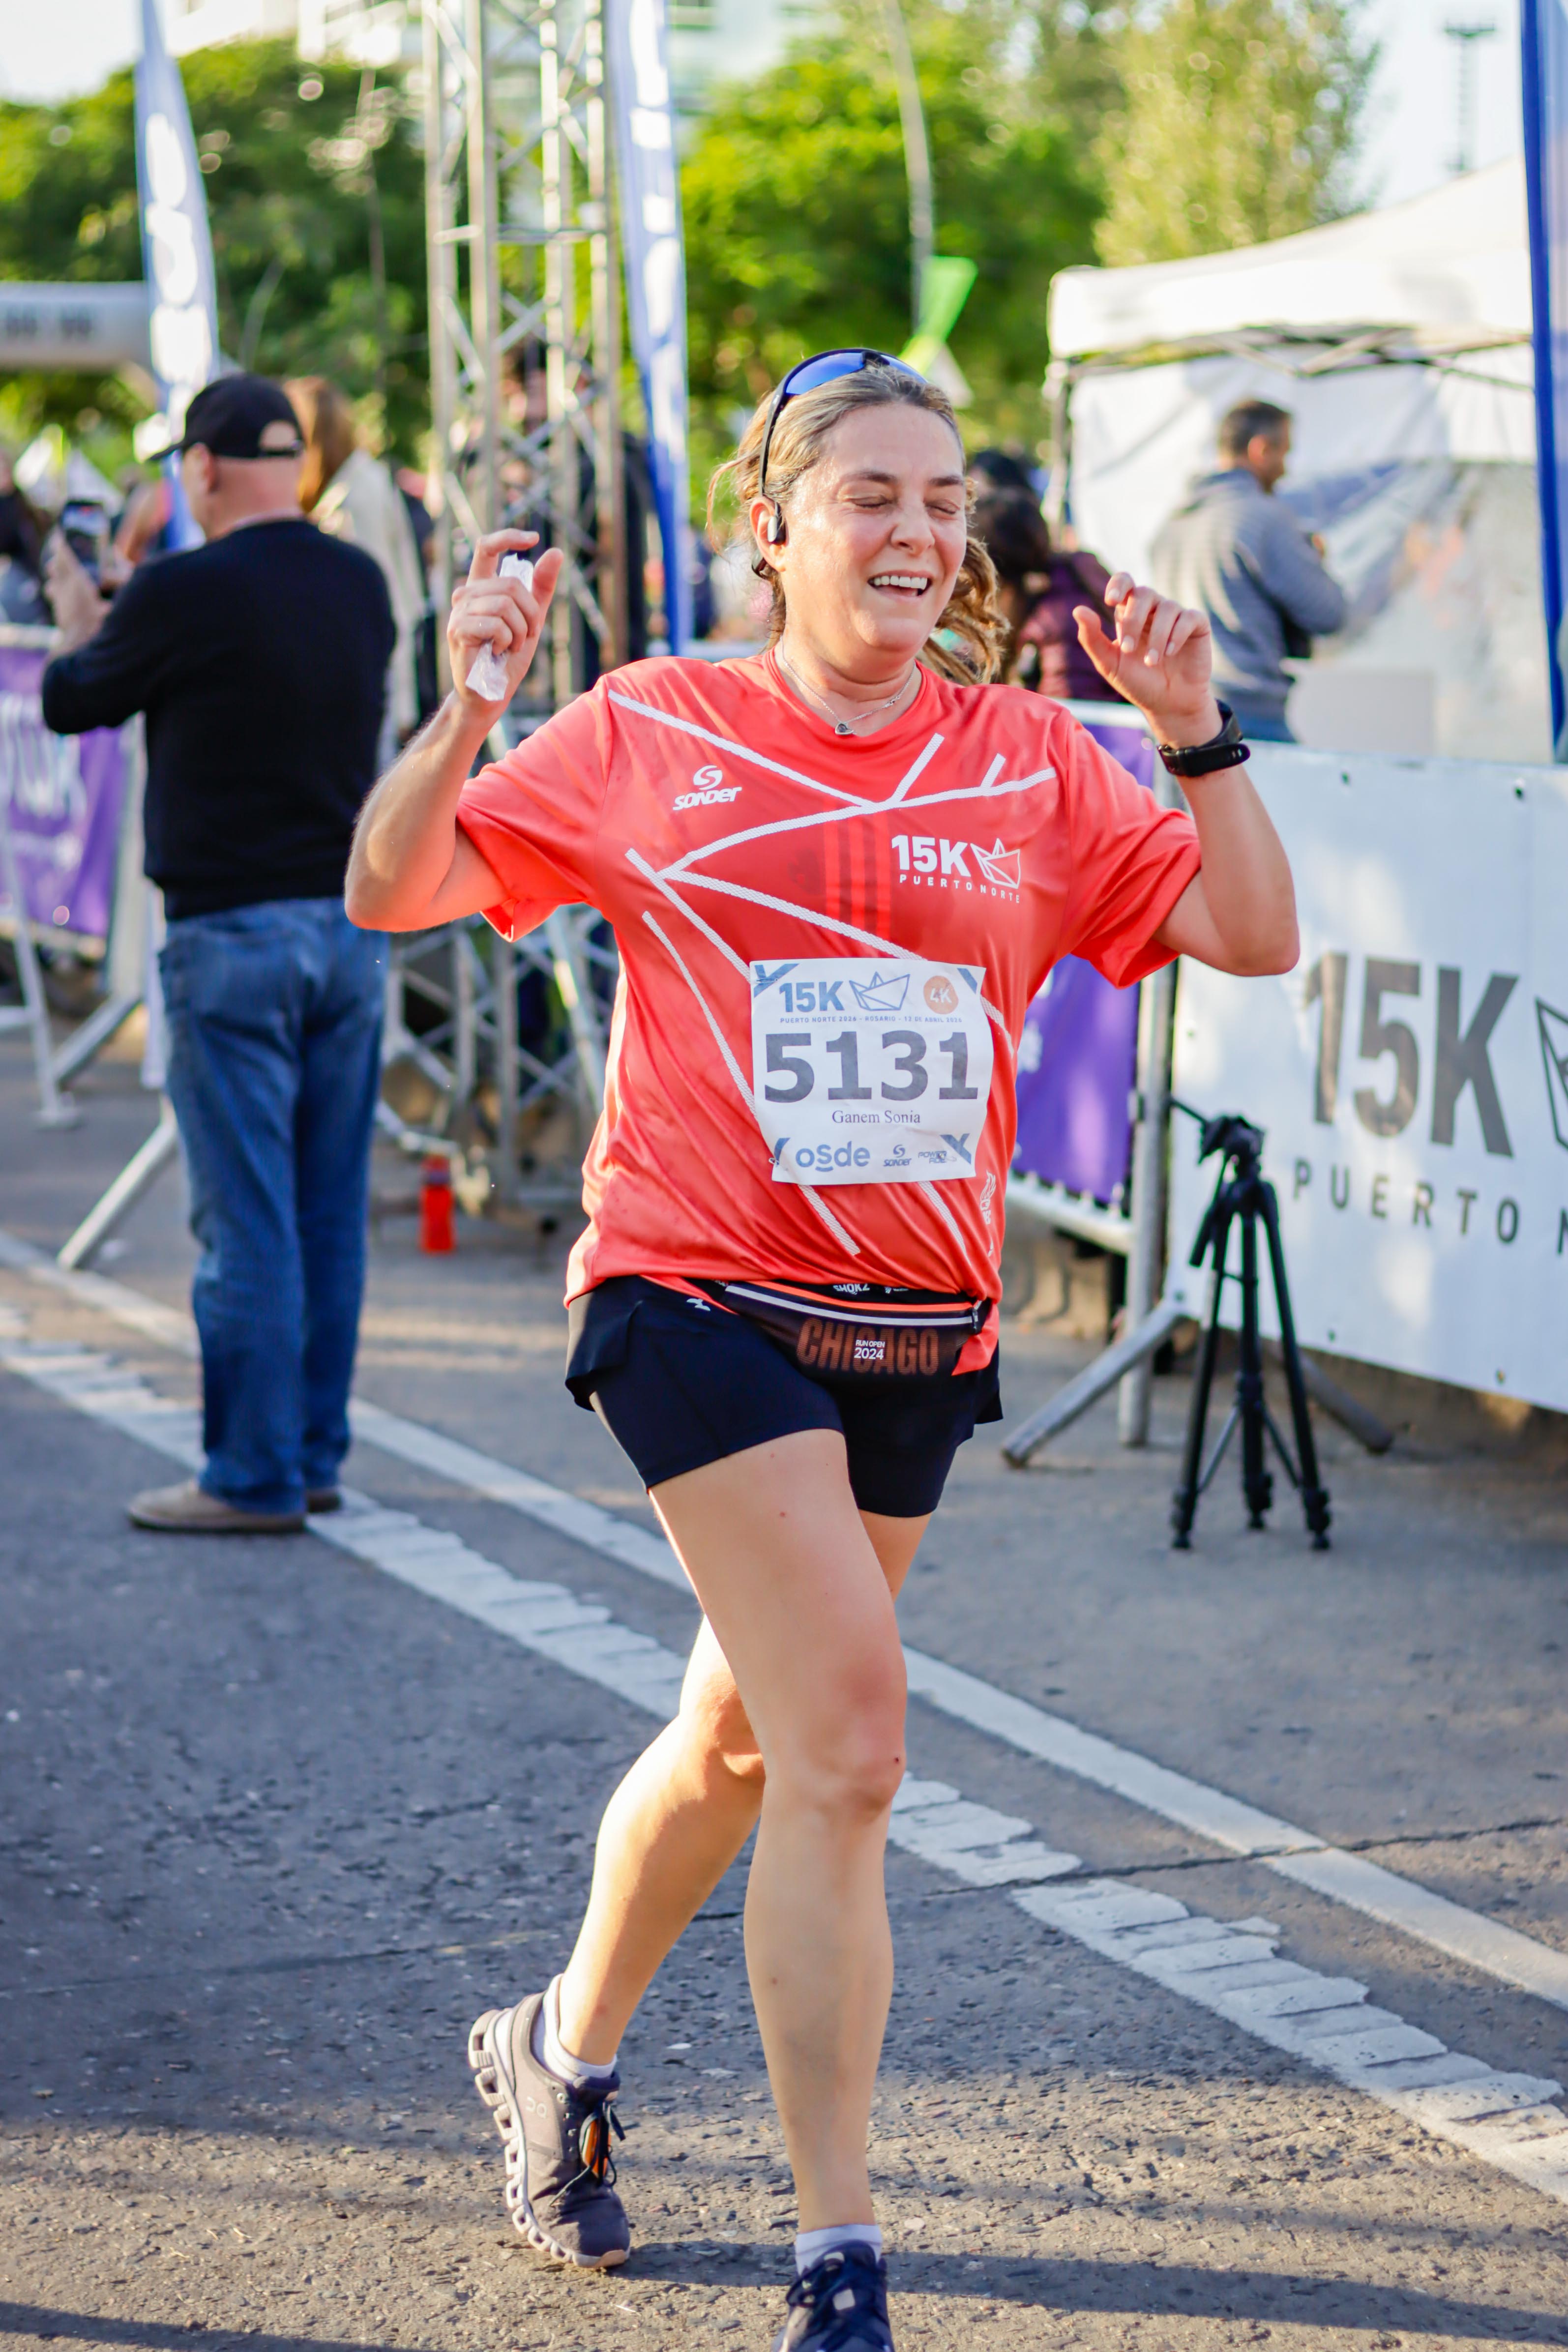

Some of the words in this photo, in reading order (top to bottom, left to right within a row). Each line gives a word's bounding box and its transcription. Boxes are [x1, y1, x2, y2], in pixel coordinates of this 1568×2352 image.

[891, 835, 971, 877] 15K
[899, 874, 972, 890] PUERTO
[980, 884, 1020, 903] NORTE
[779, 981, 844, 1013] 15K
[930, 987, 952, 1003] 4K
[765, 1030, 978, 1103] 5131
[1304, 951, 1519, 1158] 15K
[832, 1110, 880, 1123] Ganem
[885, 1110, 921, 1123] Sonia
[796, 1141, 870, 1172] osde
[1294, 1158, 1519, 1244] PUERTO
[796, 1318, 939, 1376] CHICAGO
[854, 1347, 884, 1360] 2024
